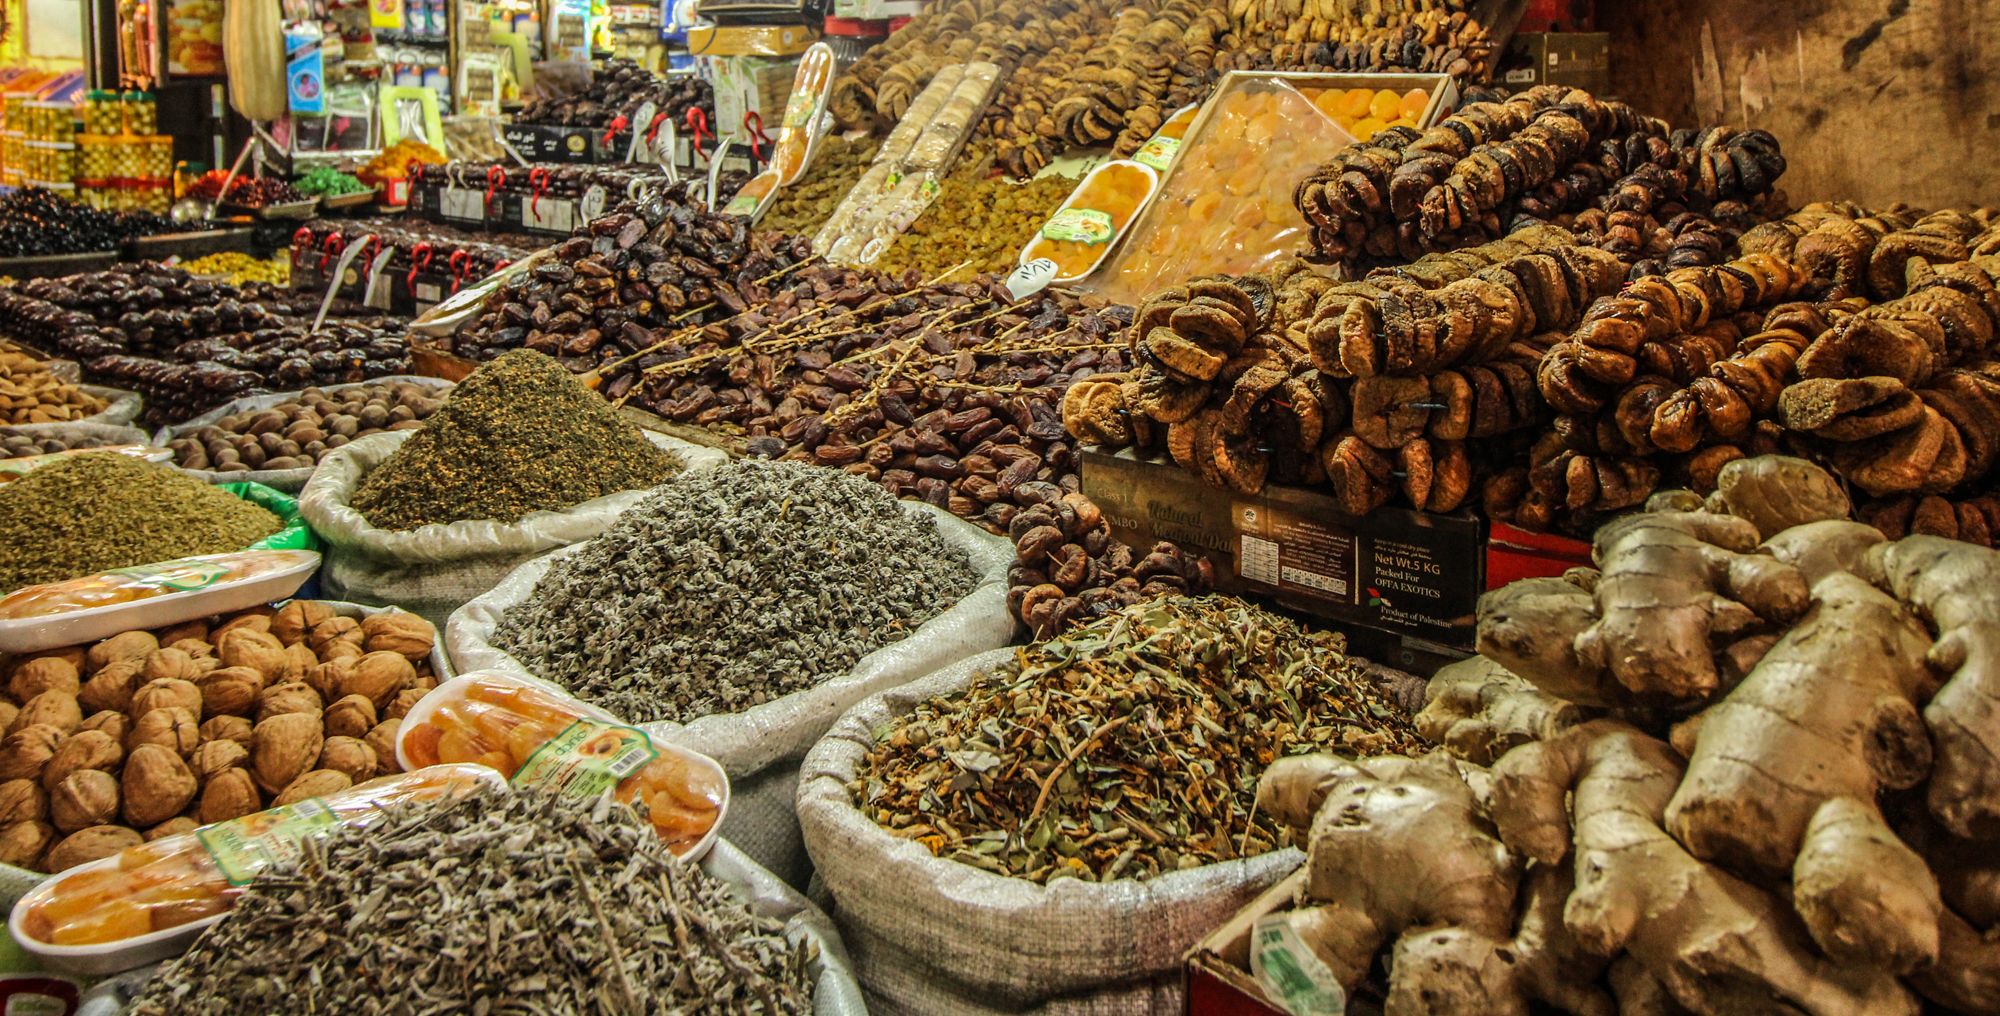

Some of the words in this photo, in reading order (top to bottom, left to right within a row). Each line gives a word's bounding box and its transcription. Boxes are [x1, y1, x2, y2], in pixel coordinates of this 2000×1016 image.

[1375, 553, 1394, 565] Net
[1423, 563, 1441, 575] KG
[1375, 566, 1403, 580] Packed
[1405, 572, 1420, 583] For
[1375, 577, 1399, 590] OFFA
[1400, 582, 1441, 598] EXOTICS
[1381, 606, 1409, 620] Product
[1409, 612, 1418, 621] of
[1419, 613, 1453, 629] Palestine
